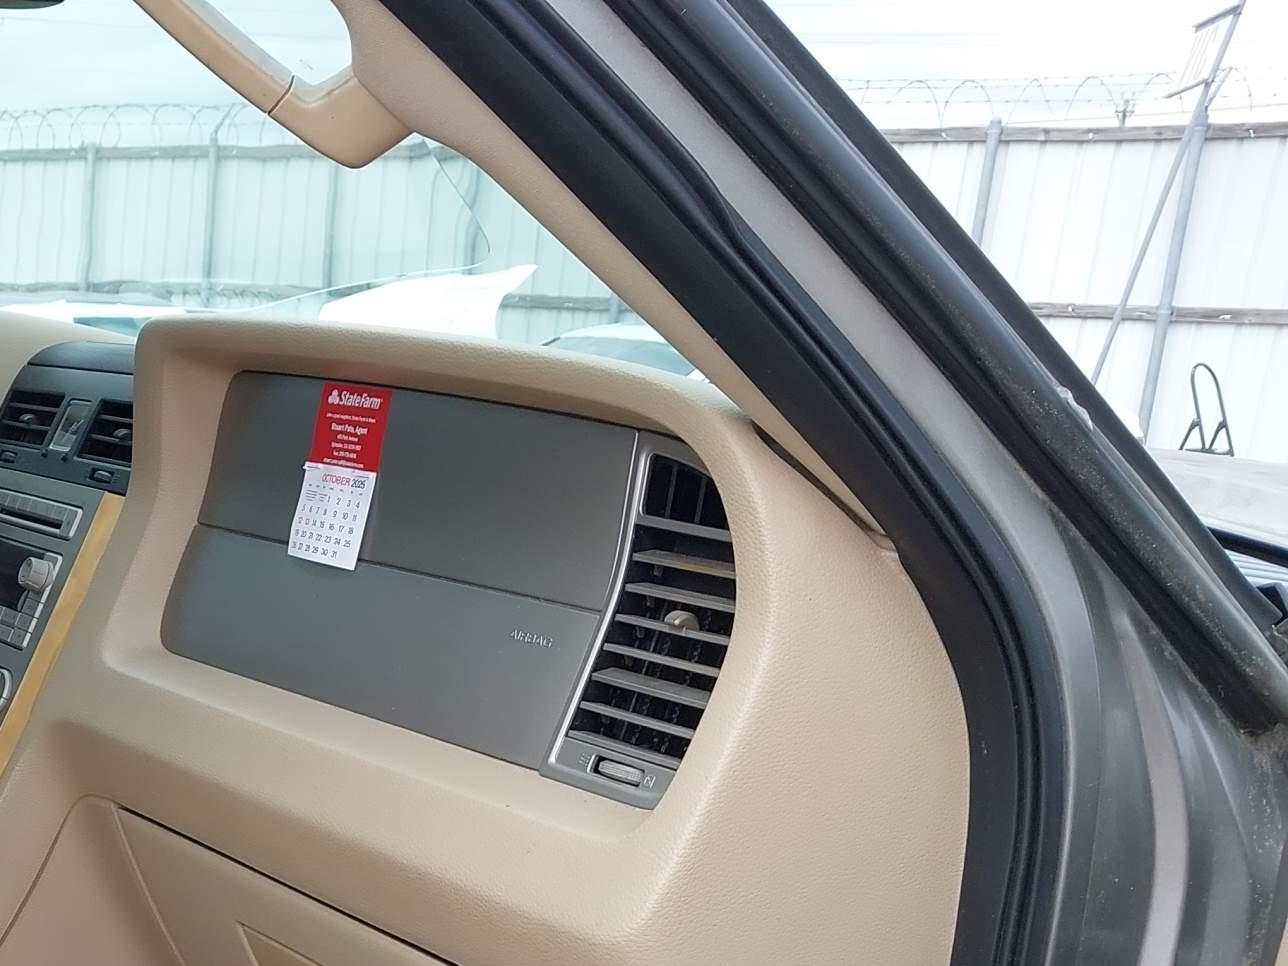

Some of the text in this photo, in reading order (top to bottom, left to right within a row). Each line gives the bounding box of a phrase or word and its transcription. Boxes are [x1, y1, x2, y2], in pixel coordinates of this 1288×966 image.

[322, 473, 366, 489] OCTOBER 2025
[510, 628, 553, 648] AIRBAG
